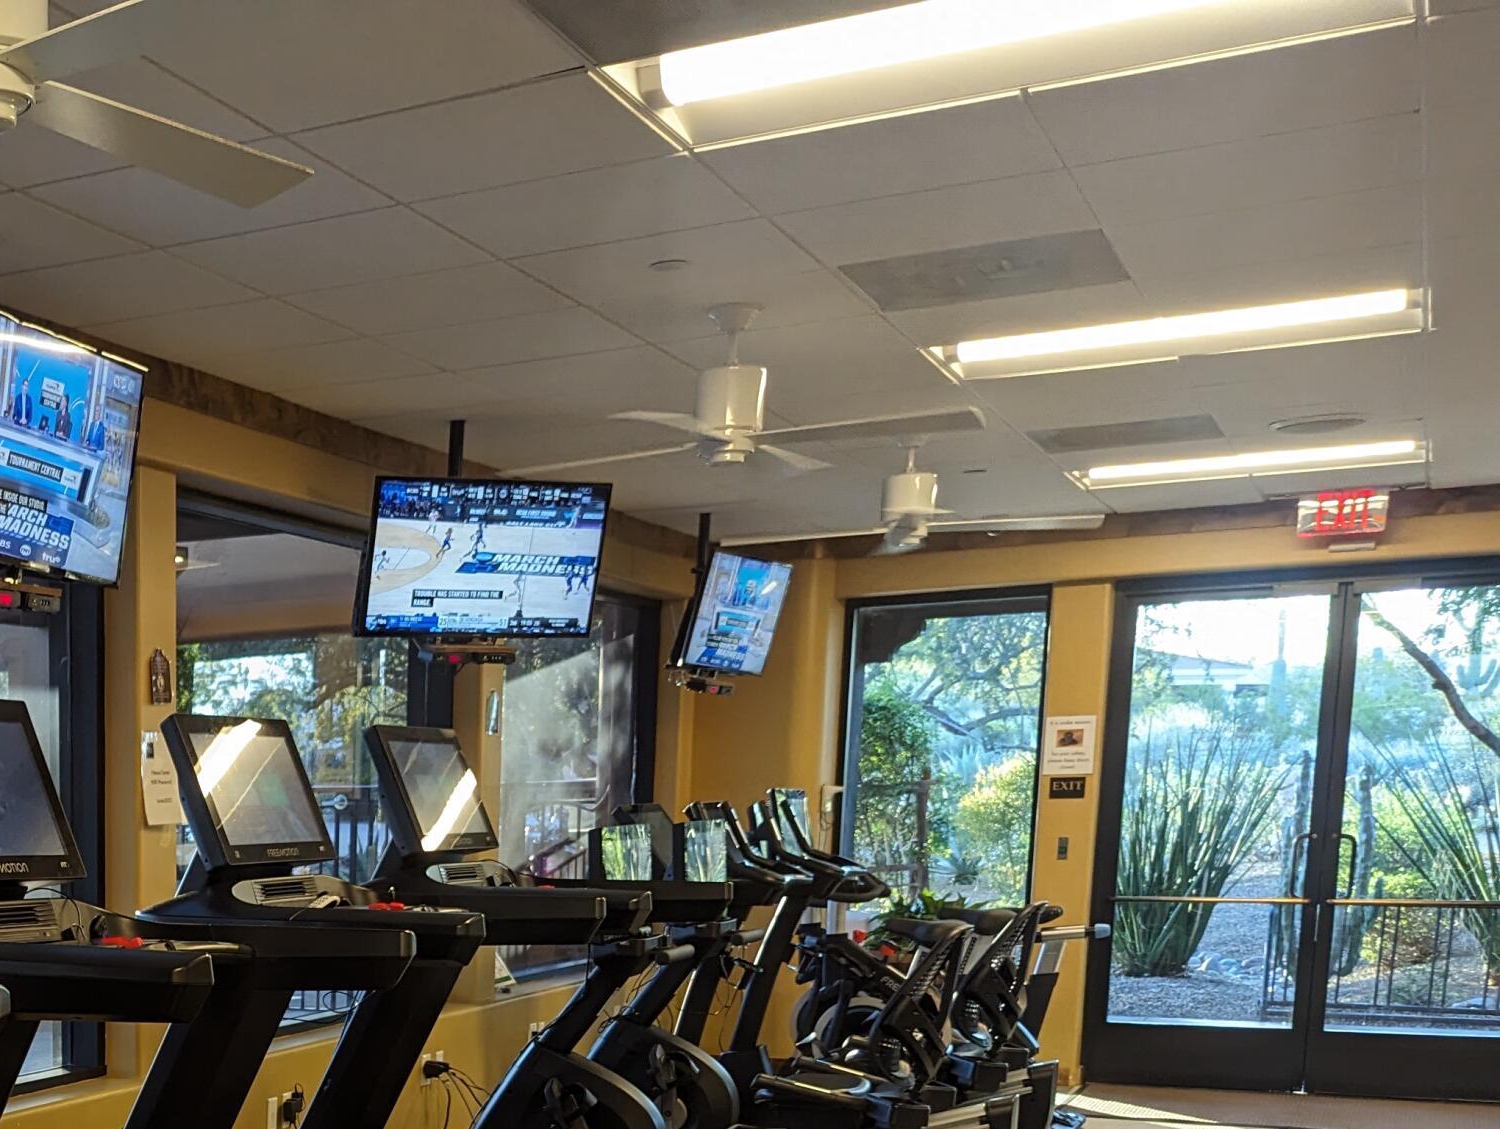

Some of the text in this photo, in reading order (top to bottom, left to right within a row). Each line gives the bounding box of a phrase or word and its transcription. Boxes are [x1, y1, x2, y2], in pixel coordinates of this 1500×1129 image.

[40, 464, 61, 480] CENTRAL
[7, 502, 48, 526] ARCH
[491, 554, 561, 564] MARCH
[1052, 781, 1083, 791] EXIT
